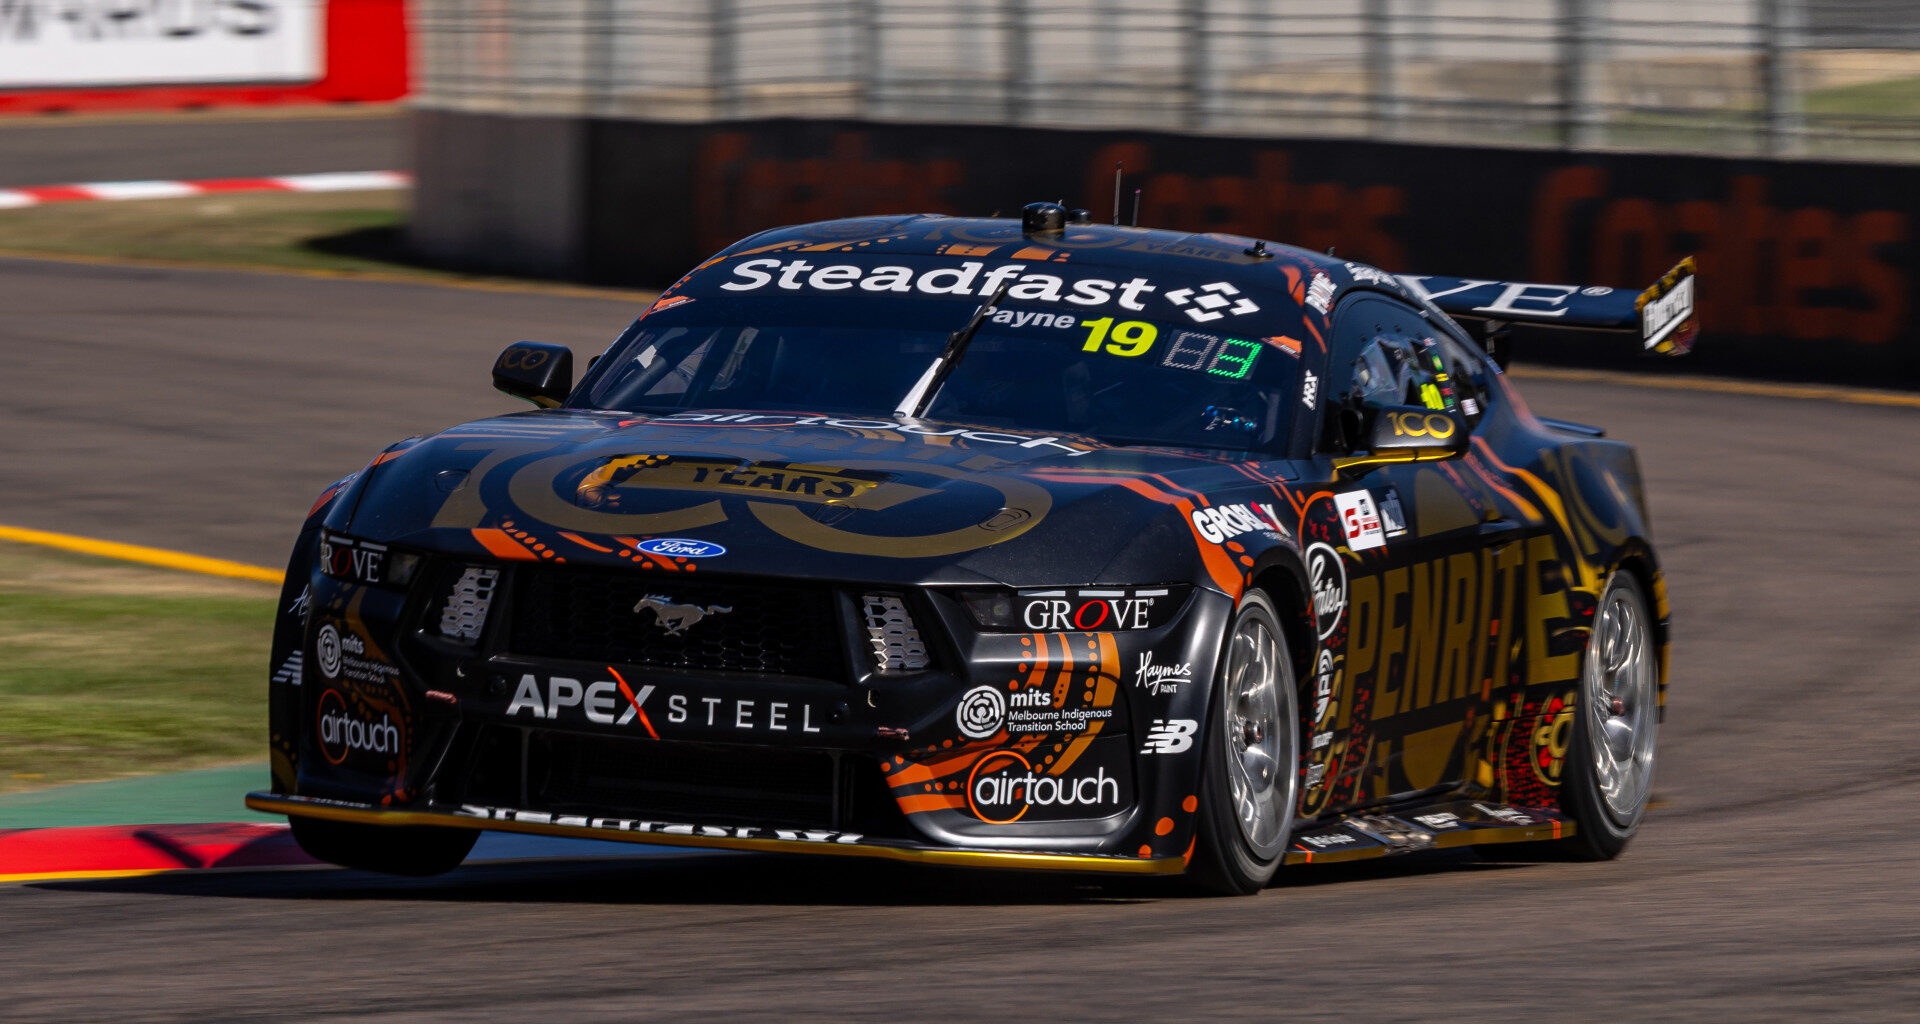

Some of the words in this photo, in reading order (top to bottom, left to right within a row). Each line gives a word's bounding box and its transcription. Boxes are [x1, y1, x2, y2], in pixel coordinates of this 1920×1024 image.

[719, 258, 1157, 312] Steadfast
[974, 304, 1076, 330] Payne
[1080, 316, 1159, 358] 19
[648, 413, 1092, 457] airtouch
[692, 466, 857, 499] YEARS
[653, 540, 709, 555] Ford
[1336, 534, 1580, 731] PENRITE
[1136, 650, 1192, 697] Haymes
[1160, 684, 1178, 694] PAINT
[506, 665, 660, 741] APEX
[667, 693, 821, 733] STEEL
[1008, 710, 1060, 721] Melbourne
[1061, 707, 1113, 721] Indigenous
[1010, 687, 1051, 707] mits
[321, 707, 399, 754] airtouch
[1007, 721, 1053, 732] Transition
[1055, 720, 1087, 732] School
[975, 766, 1119, 806] airtouch
